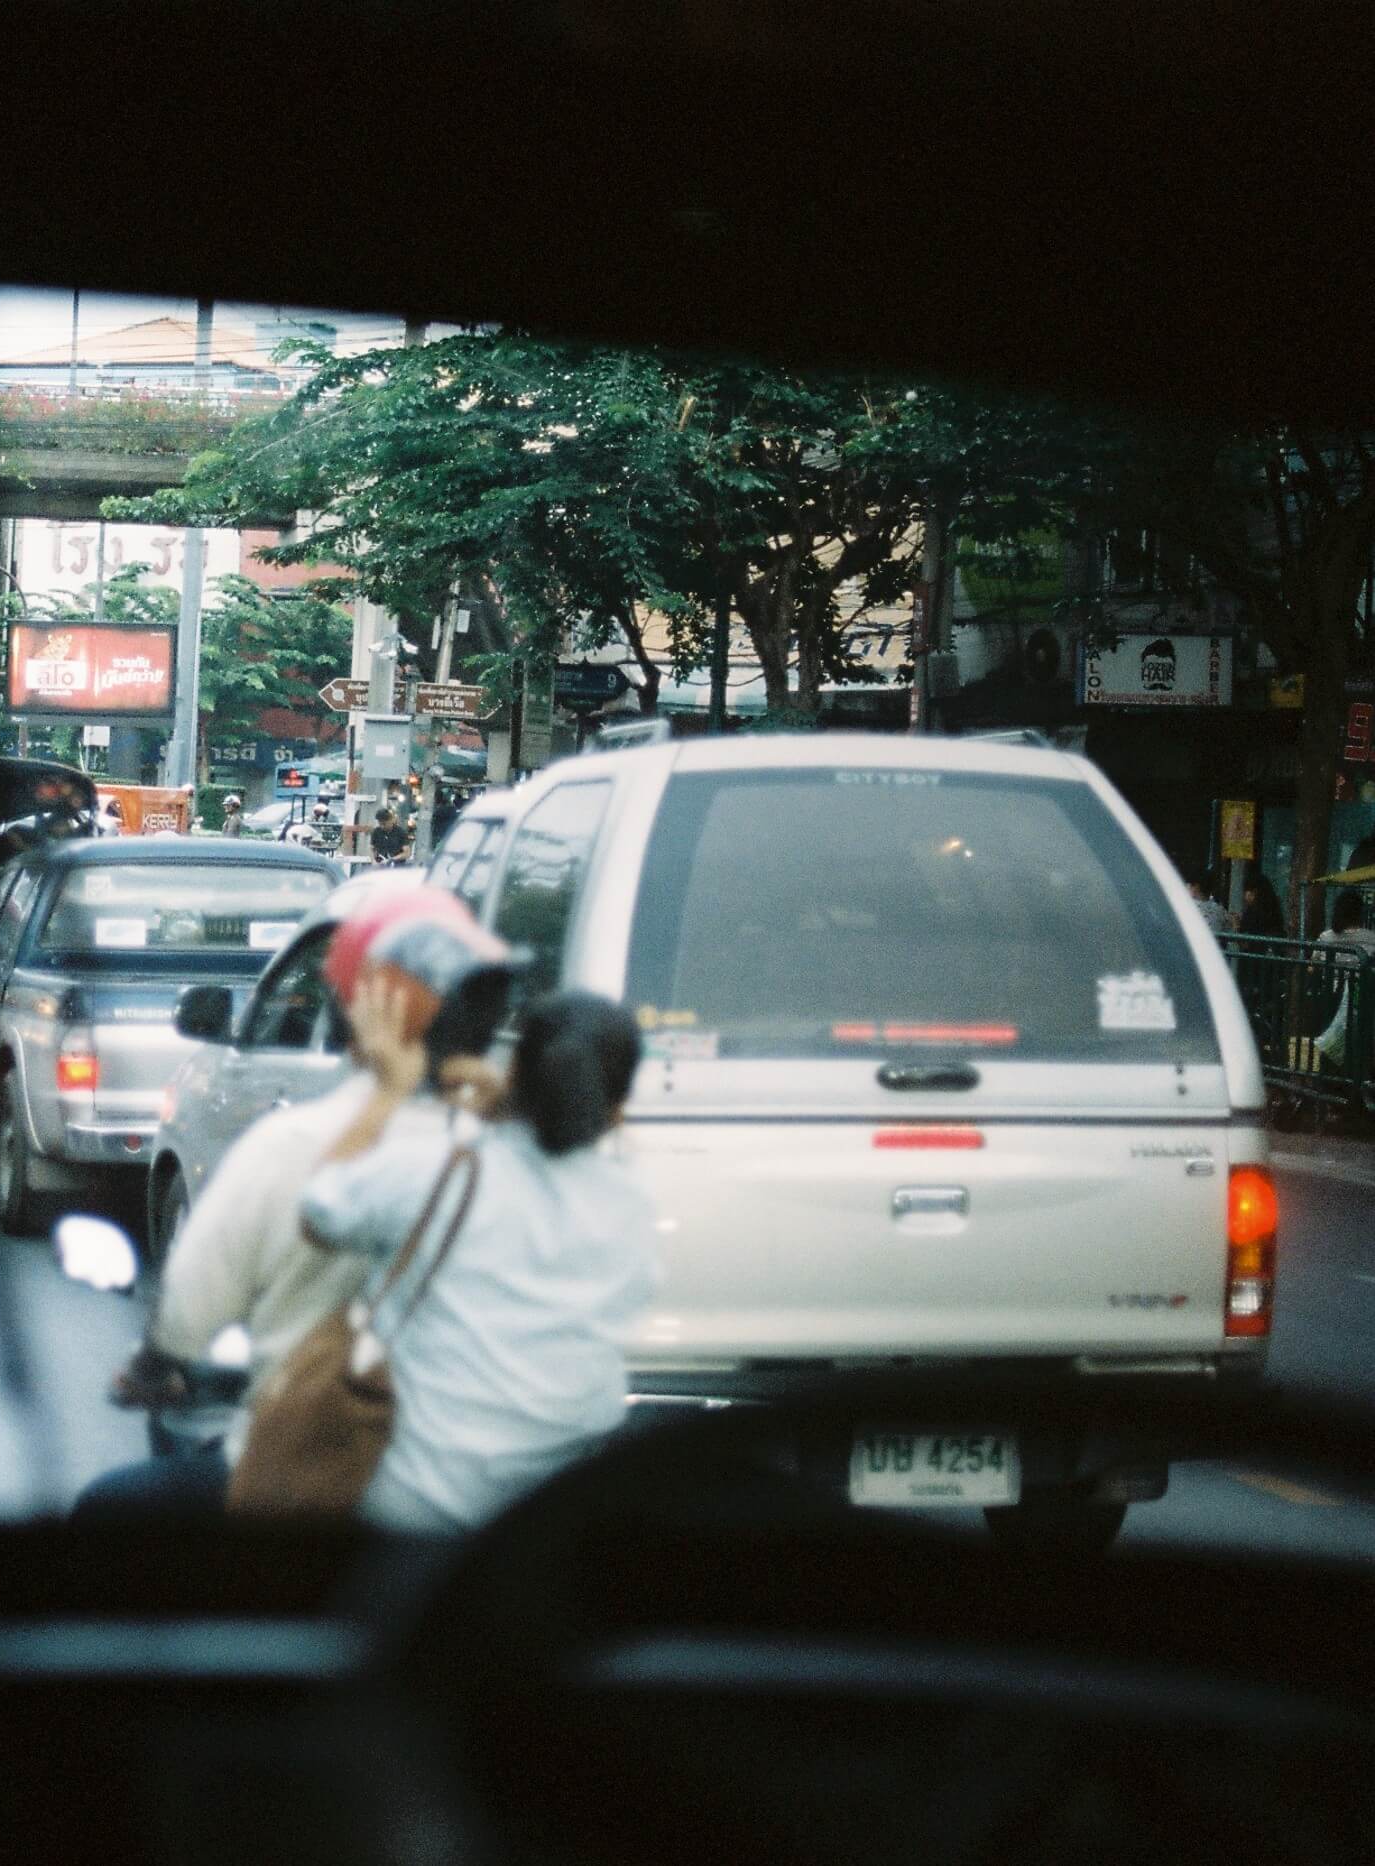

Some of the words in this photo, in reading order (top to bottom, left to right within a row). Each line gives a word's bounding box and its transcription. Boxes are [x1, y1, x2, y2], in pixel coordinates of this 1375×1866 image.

[1141, 670, 1176, 683] HAIR
[1210, 637, 1221, 704] BARBER
[143, 813, 178, 829] KERRY
